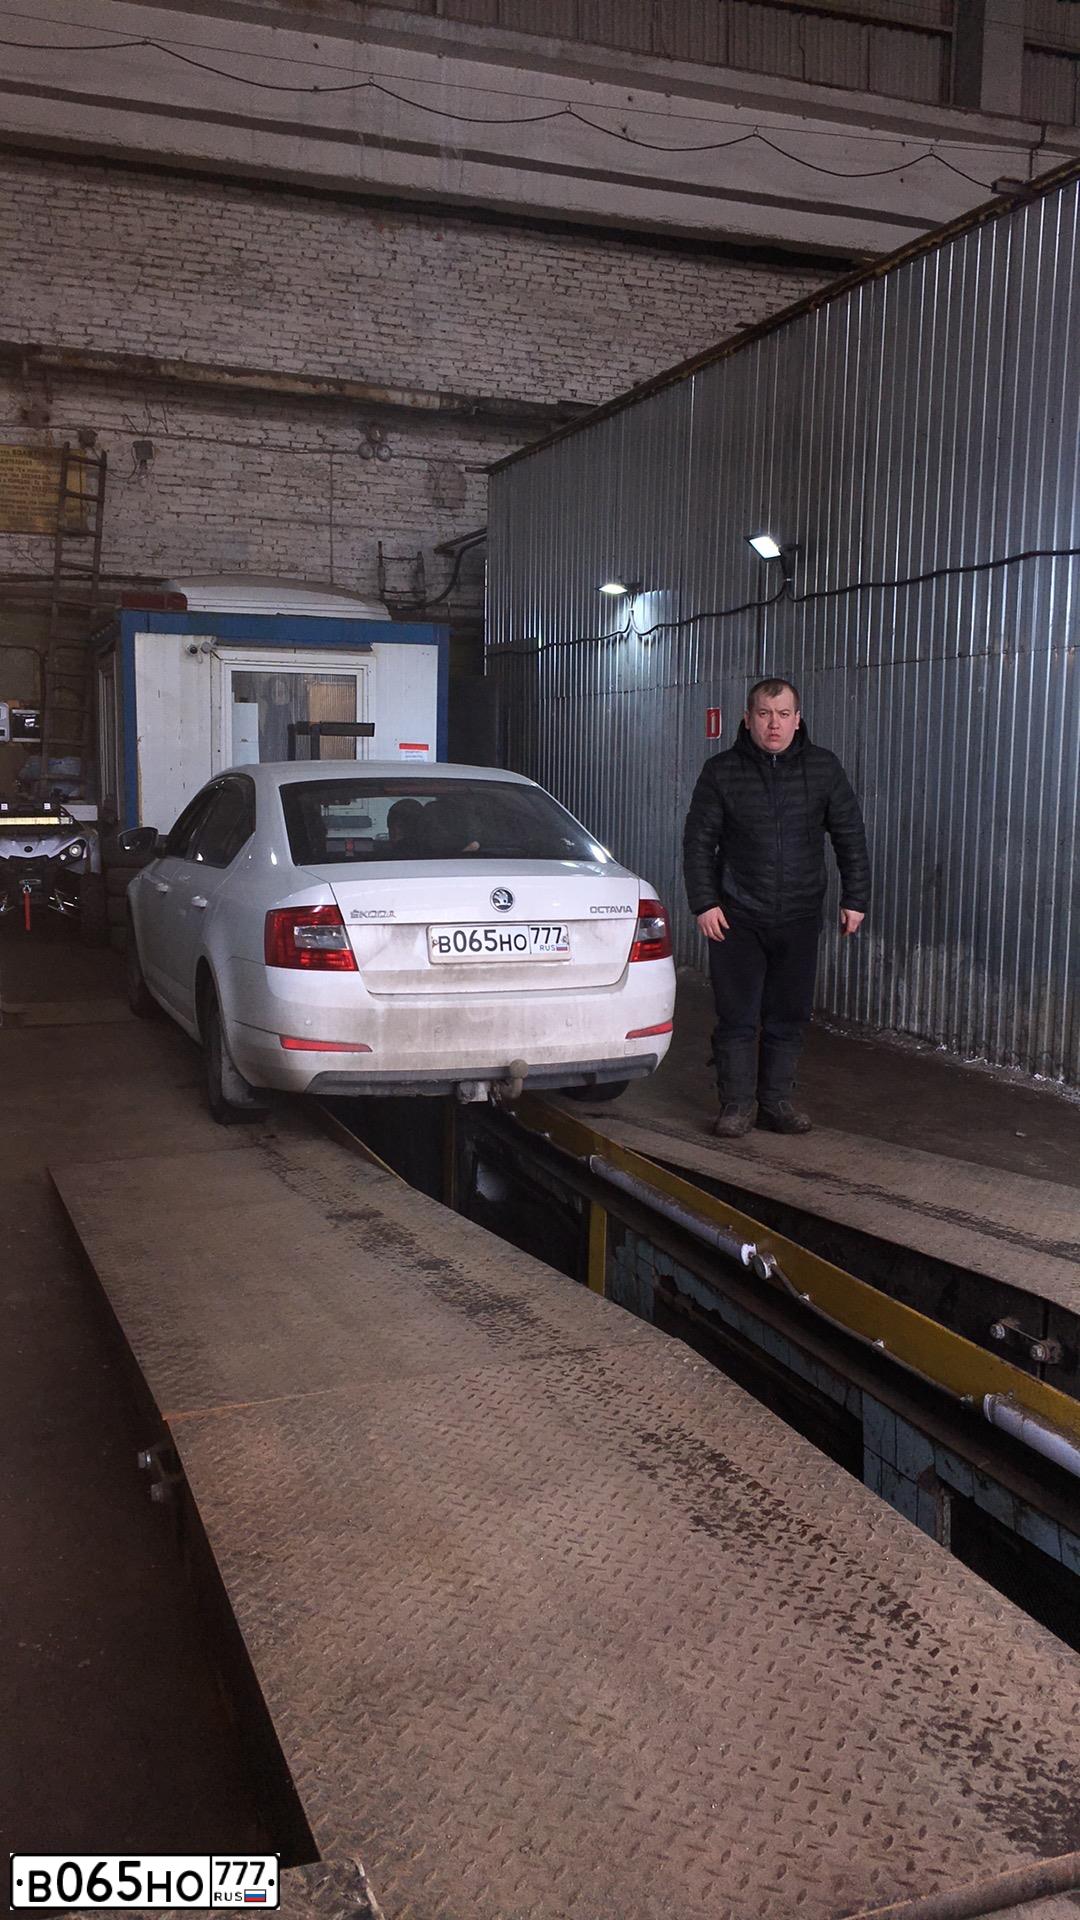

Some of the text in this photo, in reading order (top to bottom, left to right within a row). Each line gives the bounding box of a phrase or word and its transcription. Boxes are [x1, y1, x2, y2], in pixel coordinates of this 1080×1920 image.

[589, 905, 632, 914] OCTAVIA
[530, 927, 562, 945] 777
[539, 944, 557, 952] RUS
